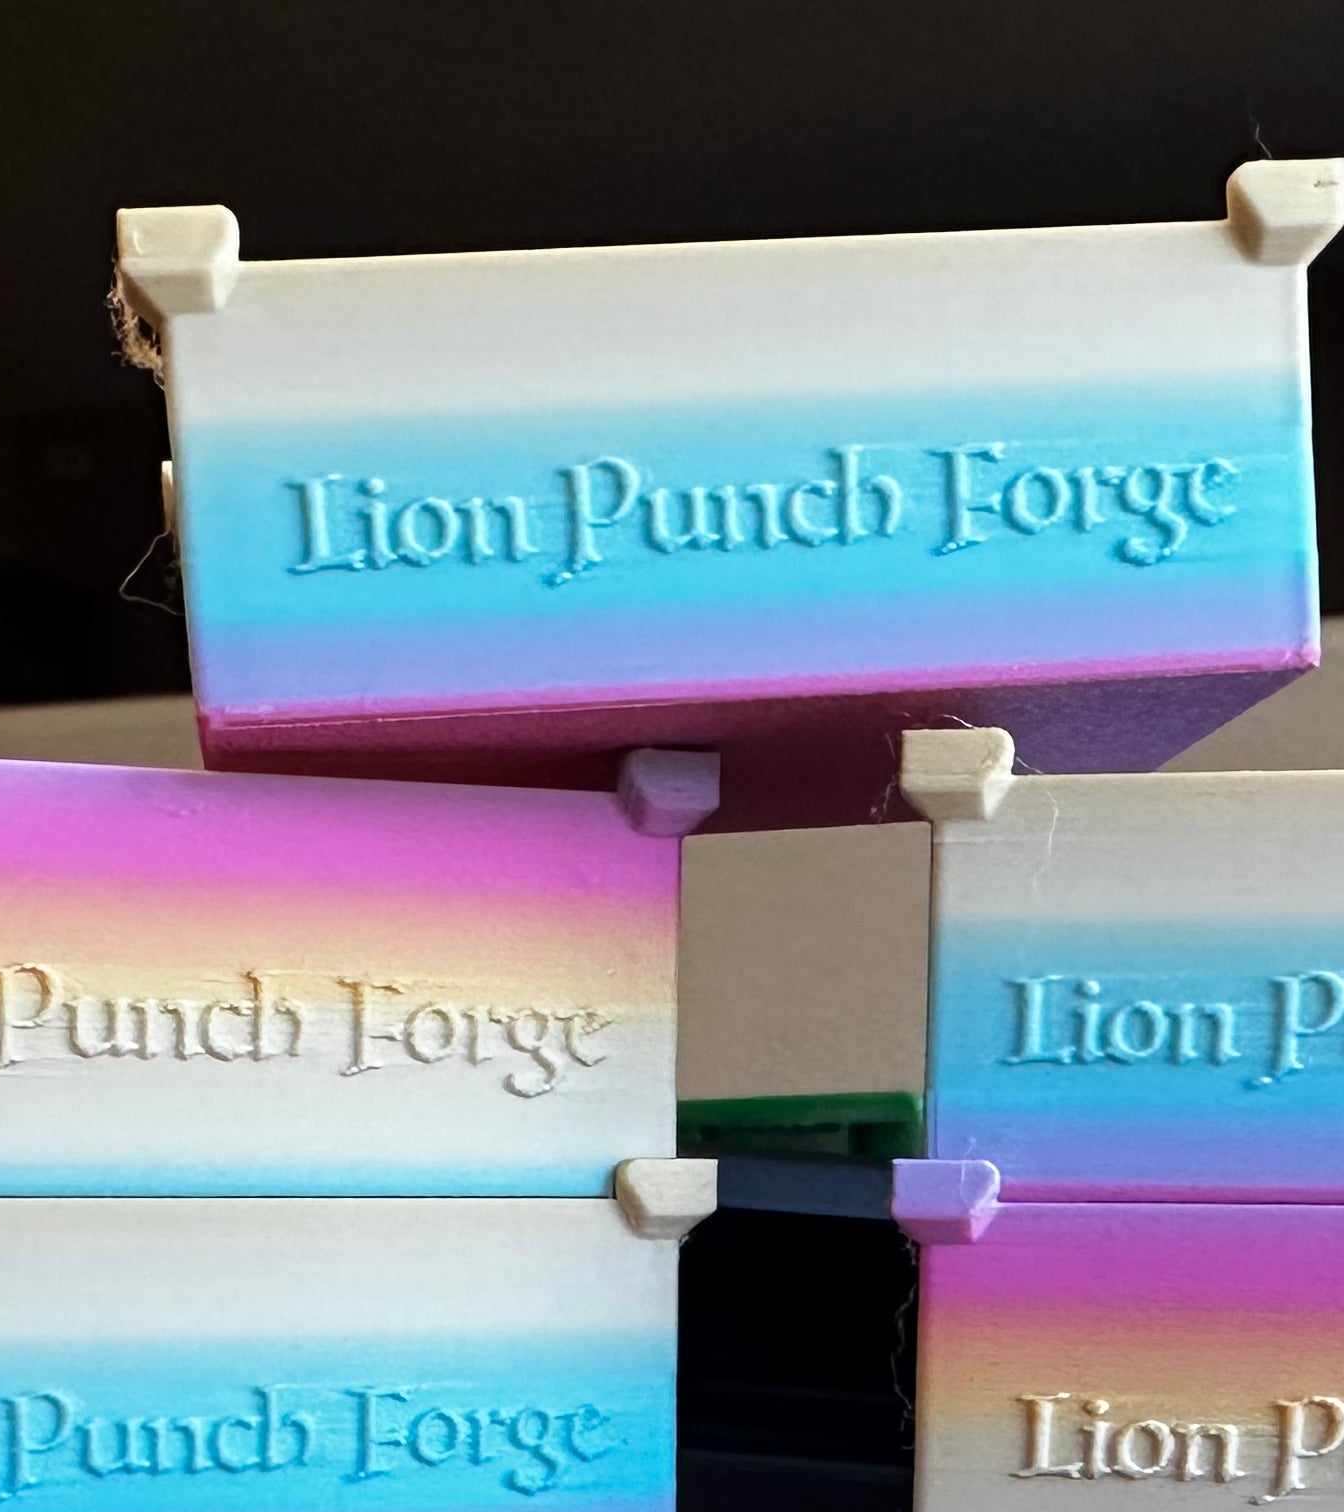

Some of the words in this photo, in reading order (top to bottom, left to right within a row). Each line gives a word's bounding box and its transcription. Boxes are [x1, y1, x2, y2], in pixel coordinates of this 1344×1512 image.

[287, 473, 540, 574] Lion
[544, 442, 903, 588] Punch
[929, 441, 1239, 567] Forge
[338, 976, 616, 1097] Forge
[1004, 974, 1242, 1066] Lion
[346, 1385, 618, 1496] Forge
[1010, 1392, 1244, 1482] Lion
